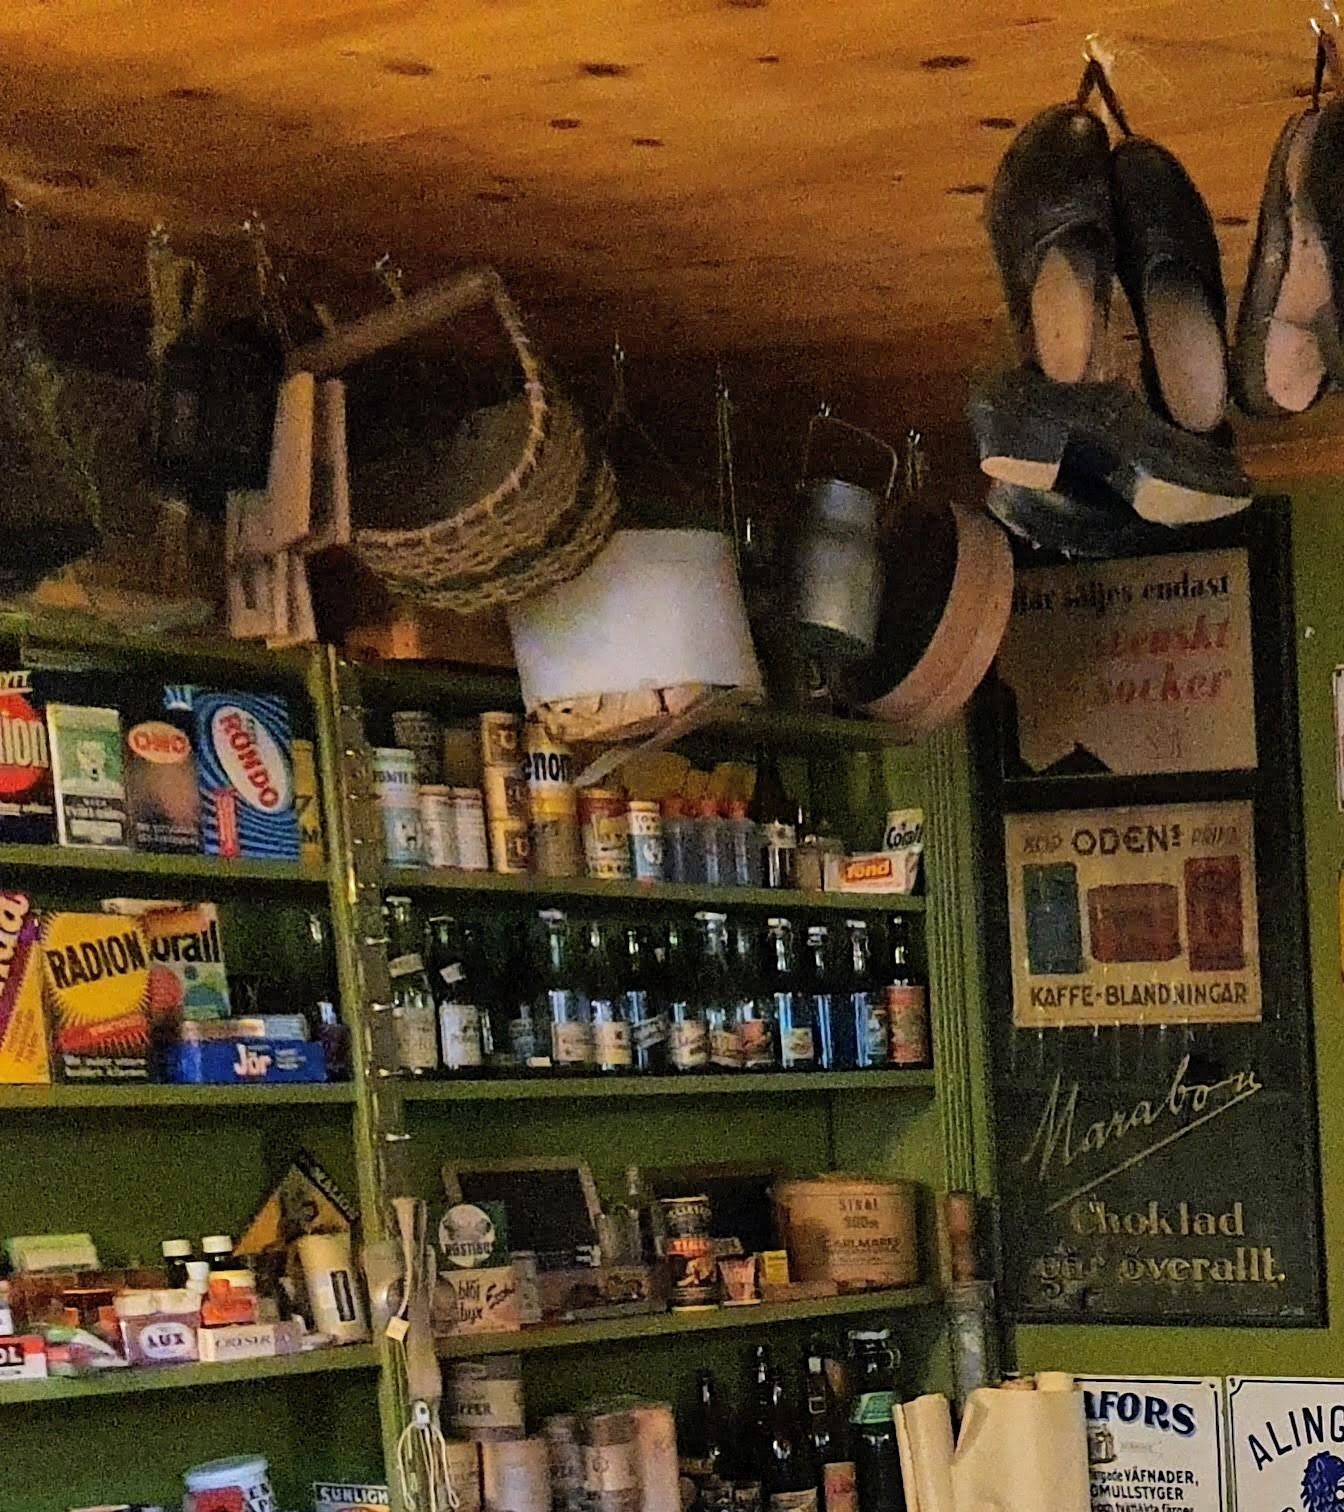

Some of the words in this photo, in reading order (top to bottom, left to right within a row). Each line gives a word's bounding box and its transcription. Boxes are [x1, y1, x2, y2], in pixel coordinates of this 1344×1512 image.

[219, 711, 279, 807] RONDO
[46, 929, 148, 990] RADION
[1069, 1199, 1245, 1237] Choklad
[319, 1486, 389, 1505] SUNLIGH
